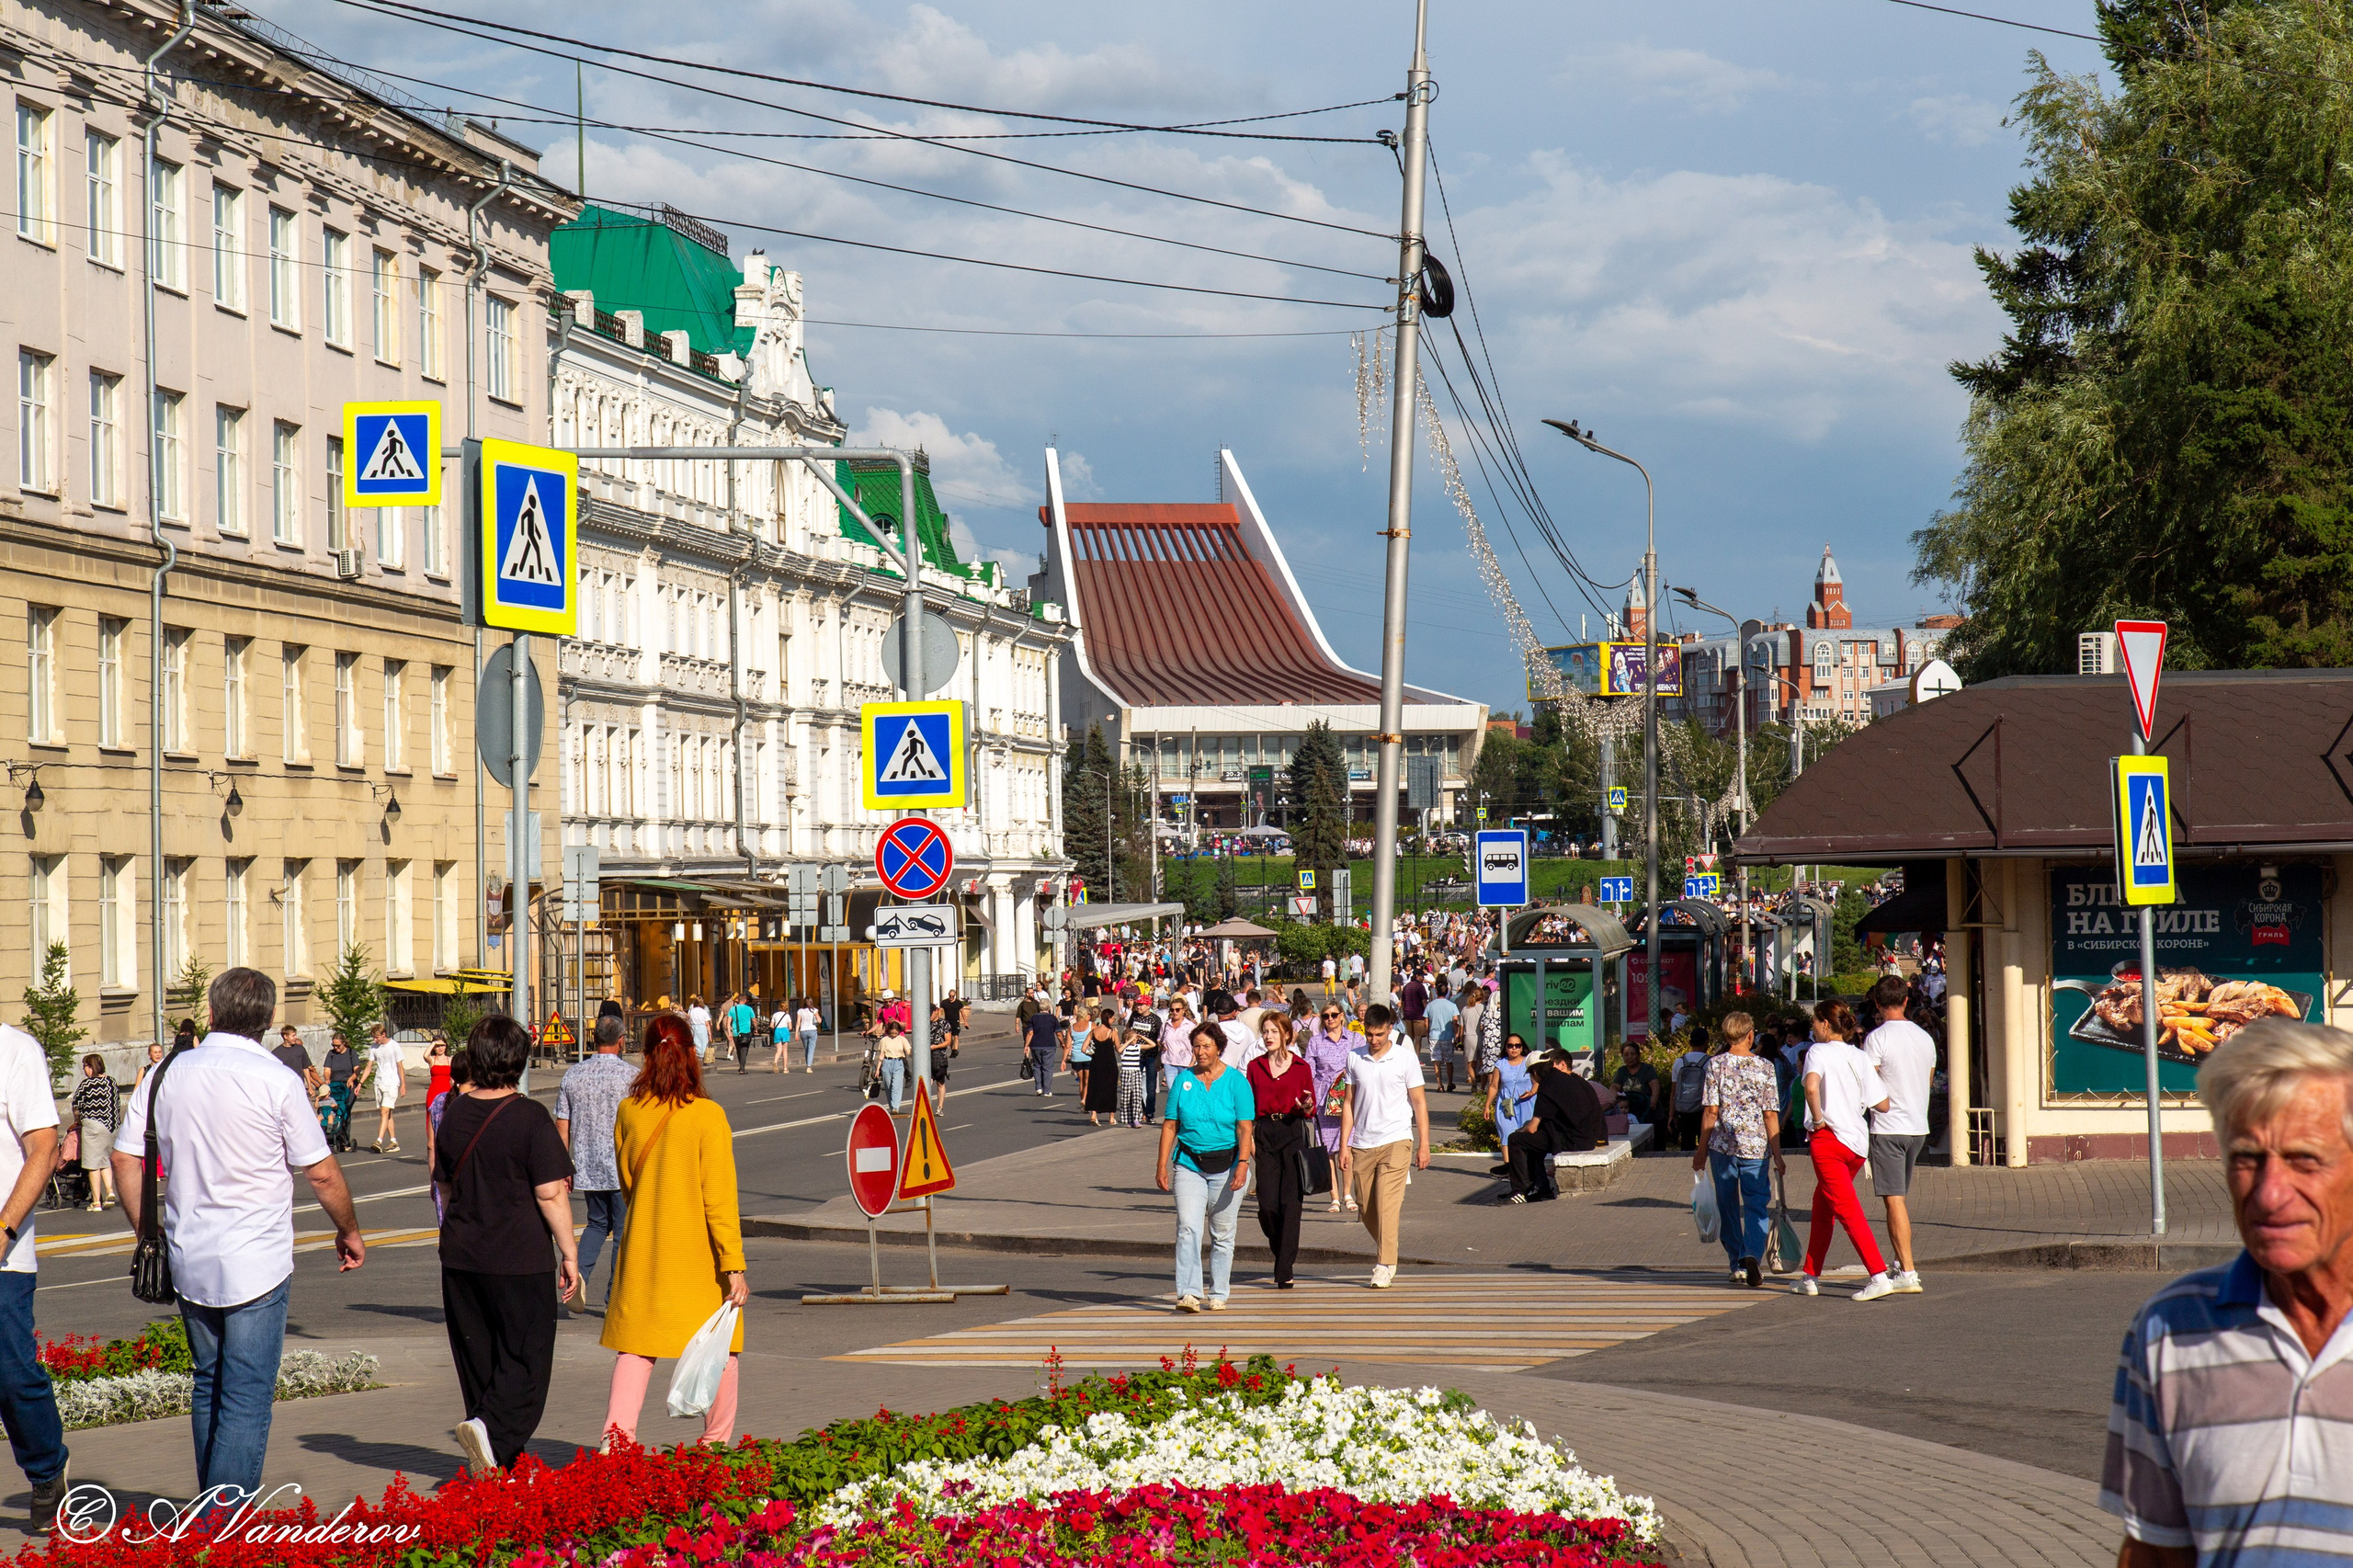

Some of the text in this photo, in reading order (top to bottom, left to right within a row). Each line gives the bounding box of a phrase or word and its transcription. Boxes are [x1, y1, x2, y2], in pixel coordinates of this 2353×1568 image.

[2066, 883, 2187, 907] БЛА
[2248, 903, 2292, 913] СИБИРСКАЯ
[2067, 911, 2114, 935] НА
[2254, 913, 2287, 923] КОРОНА
[2067, 940, 2075, 950] В
[2156, 939, 2210, 949] КОРОНЕ»
[1547, 1009, 1584, 1017] вашим
[1530, 1019, 1585, 1028] павилам
